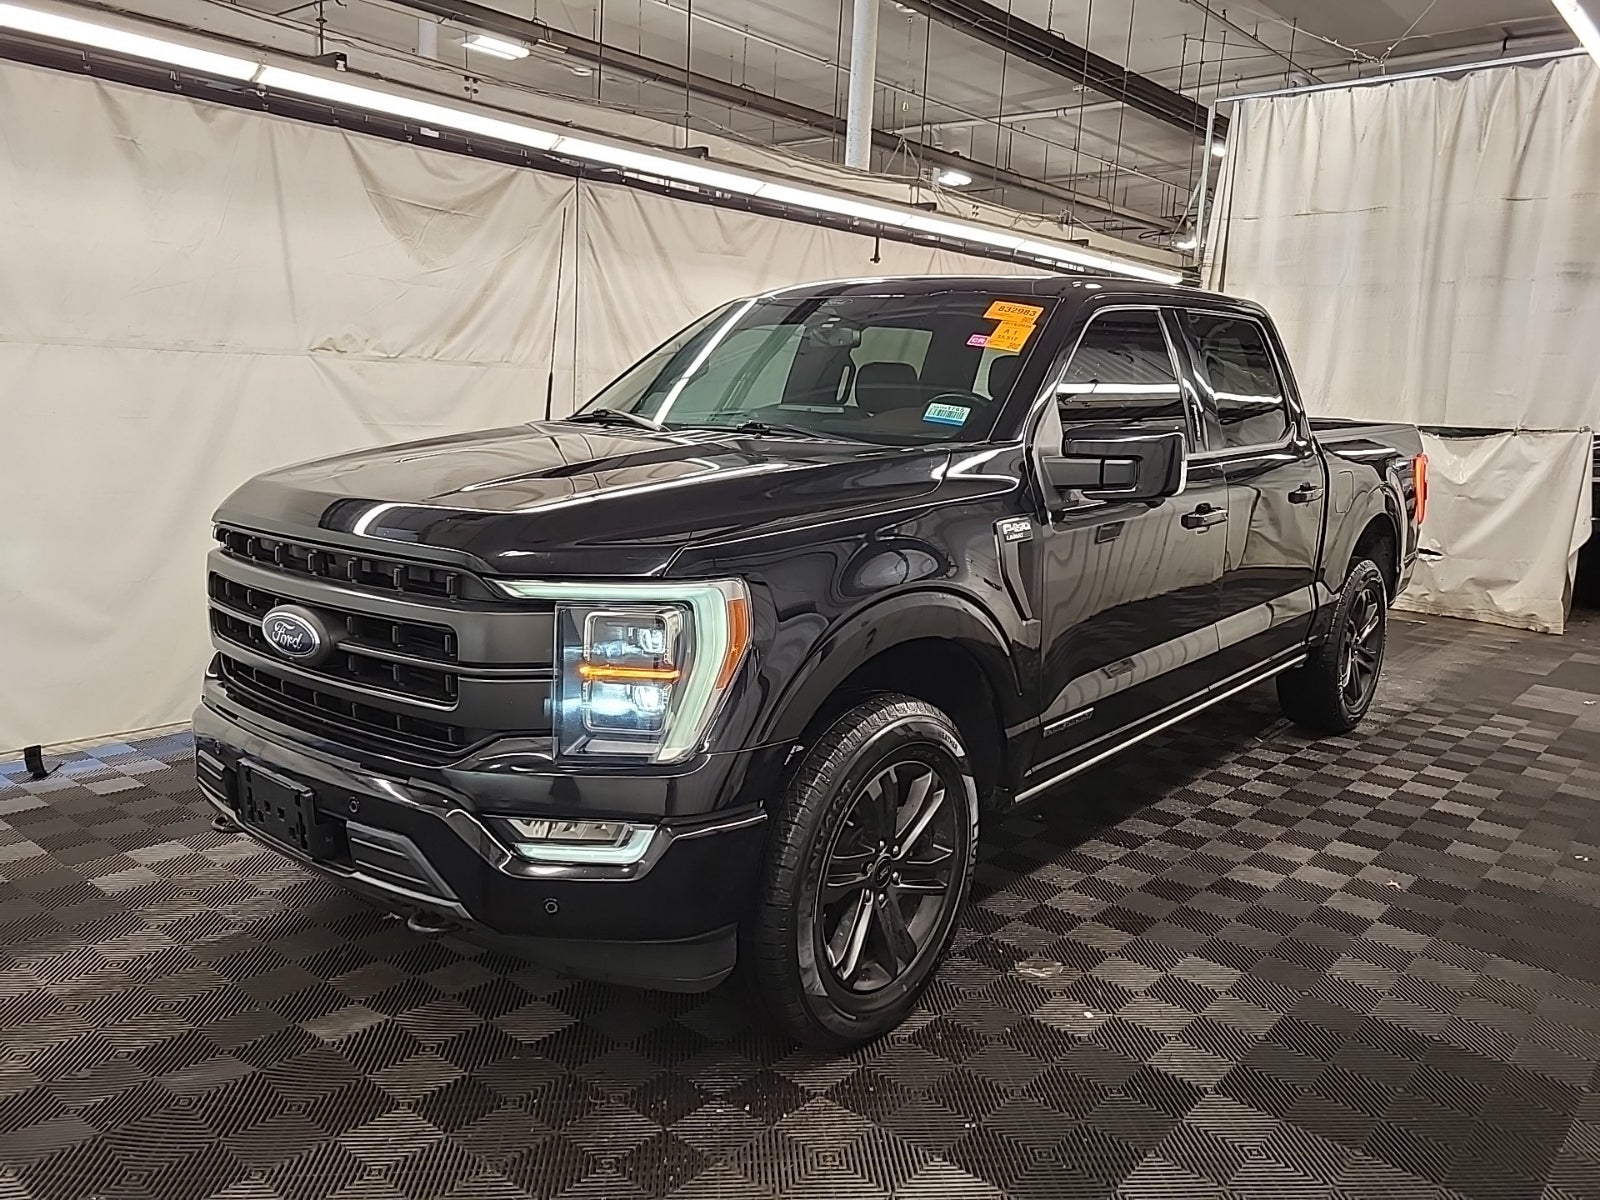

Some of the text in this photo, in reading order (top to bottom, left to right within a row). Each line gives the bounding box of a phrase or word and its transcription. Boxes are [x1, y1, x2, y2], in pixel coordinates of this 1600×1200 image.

[998, 305, 1037, 317] 832983
[971, 337, 986, 345] CR
[272, 620, 303, 650] Ford
